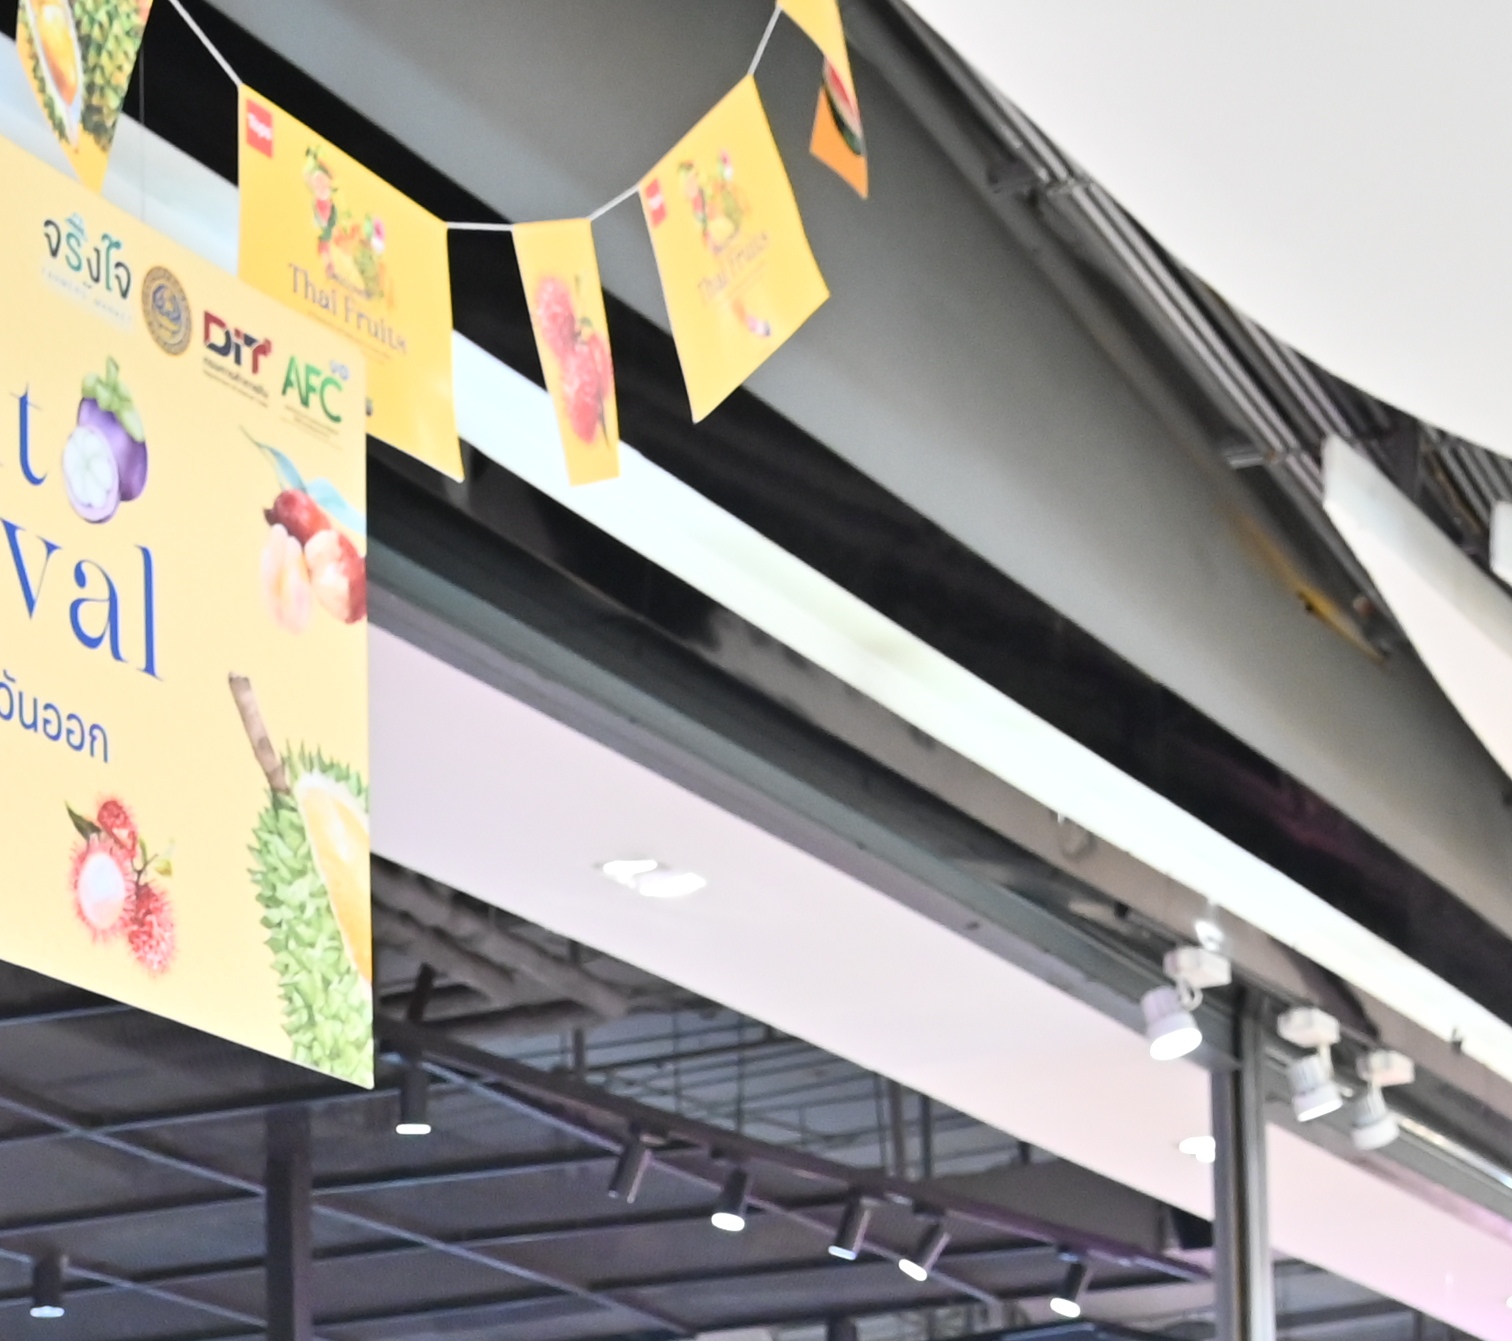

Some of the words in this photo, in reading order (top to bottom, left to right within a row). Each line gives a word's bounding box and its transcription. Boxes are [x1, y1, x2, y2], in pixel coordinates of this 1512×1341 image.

[288, 262, 337, 316] Thai
[342, 293, 407, 356] Fruits
[281, 356, 343, 423] AFC
